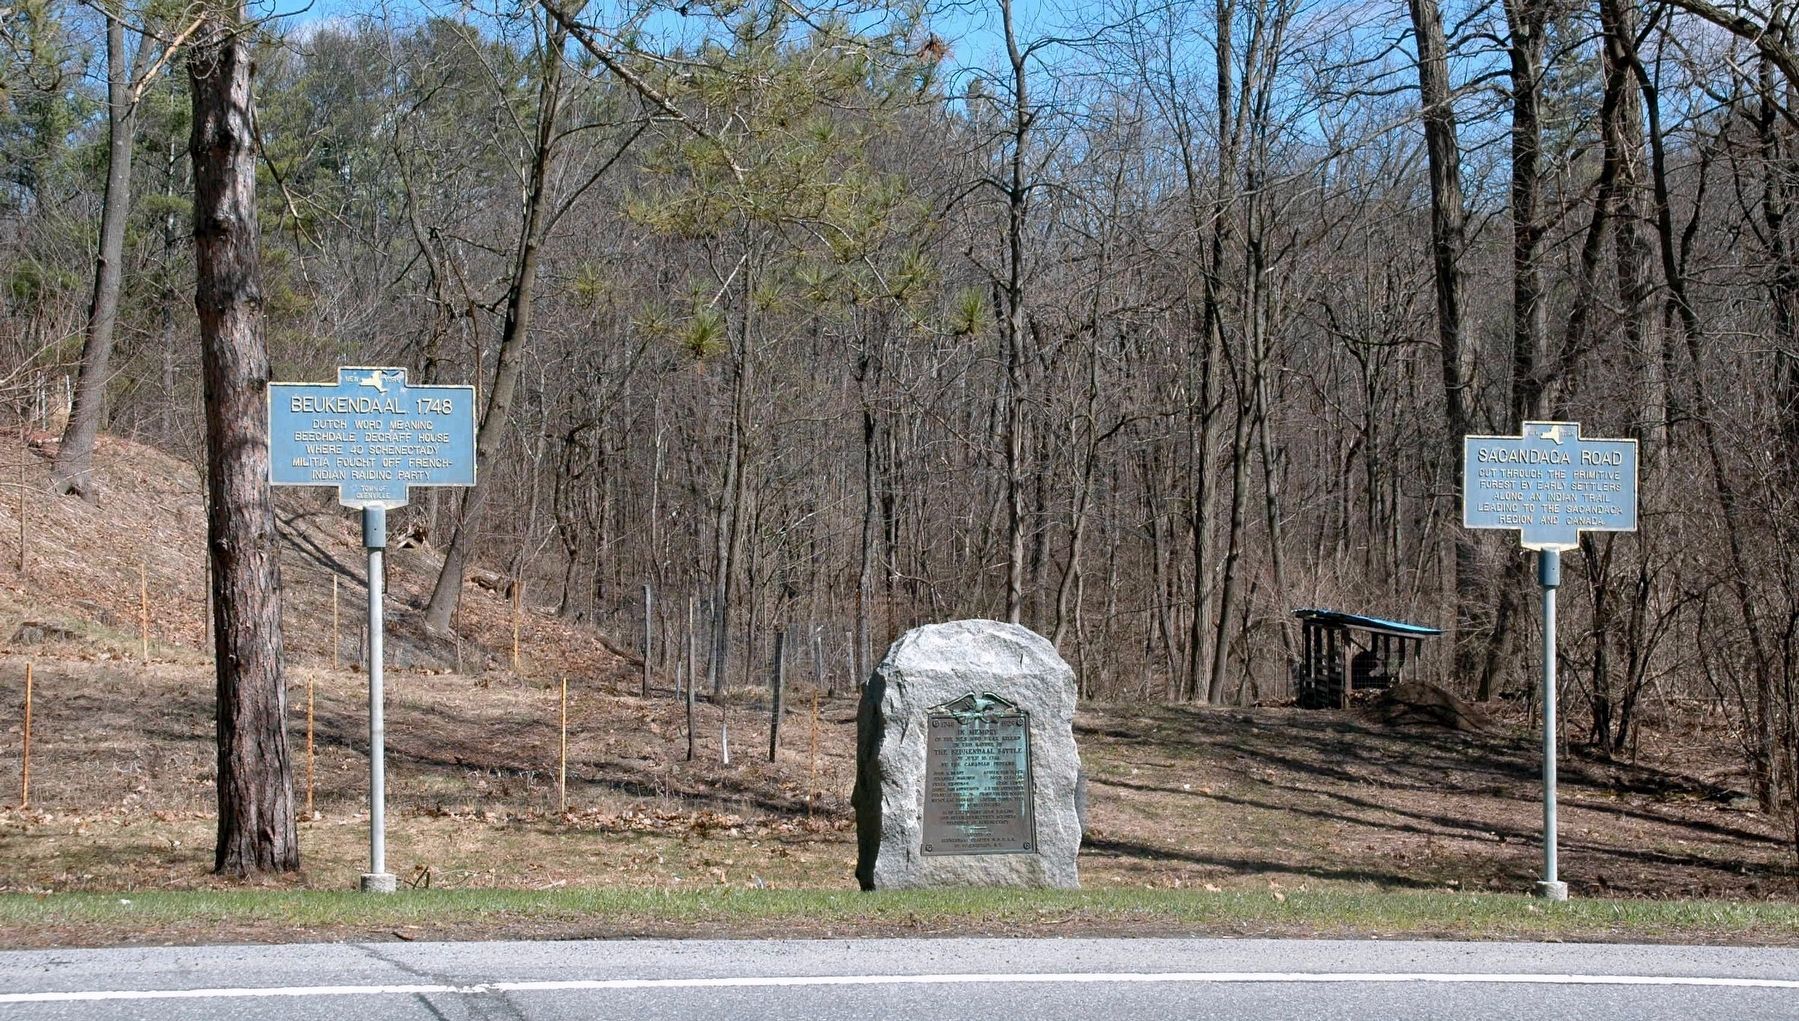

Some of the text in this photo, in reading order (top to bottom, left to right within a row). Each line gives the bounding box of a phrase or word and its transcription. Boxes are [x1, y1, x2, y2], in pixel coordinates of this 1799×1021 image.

[416, 398, 453, 415] 1748
[312, 419, 433, 431] DUTCH WORD MEANING
[364, 432, 412, 443] DEGRAFF
[417, 432, 450, 443] HOUSE
[305, 444, 439, 456] WHERE 40 SCHENECTADY
[292, 457, 453, 468] MILITIA FOUGHT OFF FRENCH-
[1478, 448, 1622, 466] SACANDAGA ROAD
[312, 469, 431, 481] INDIAN RAIDING PARTY
[1479, 468, 1621, 481] CUT THROUGH THE PRIMITIVE
[1479, 480, 1622, 492] FOREST BY EARLY SETTLERS
[1492, 491, 1611, 503] ALONG AN INDIAN TRAIL
[1477, 502, 1623, 515] LEADING TO THE SACANDAGA
[1498, 514, 1533, 525] REGION
[1539, 515, 1560, 525] AND
